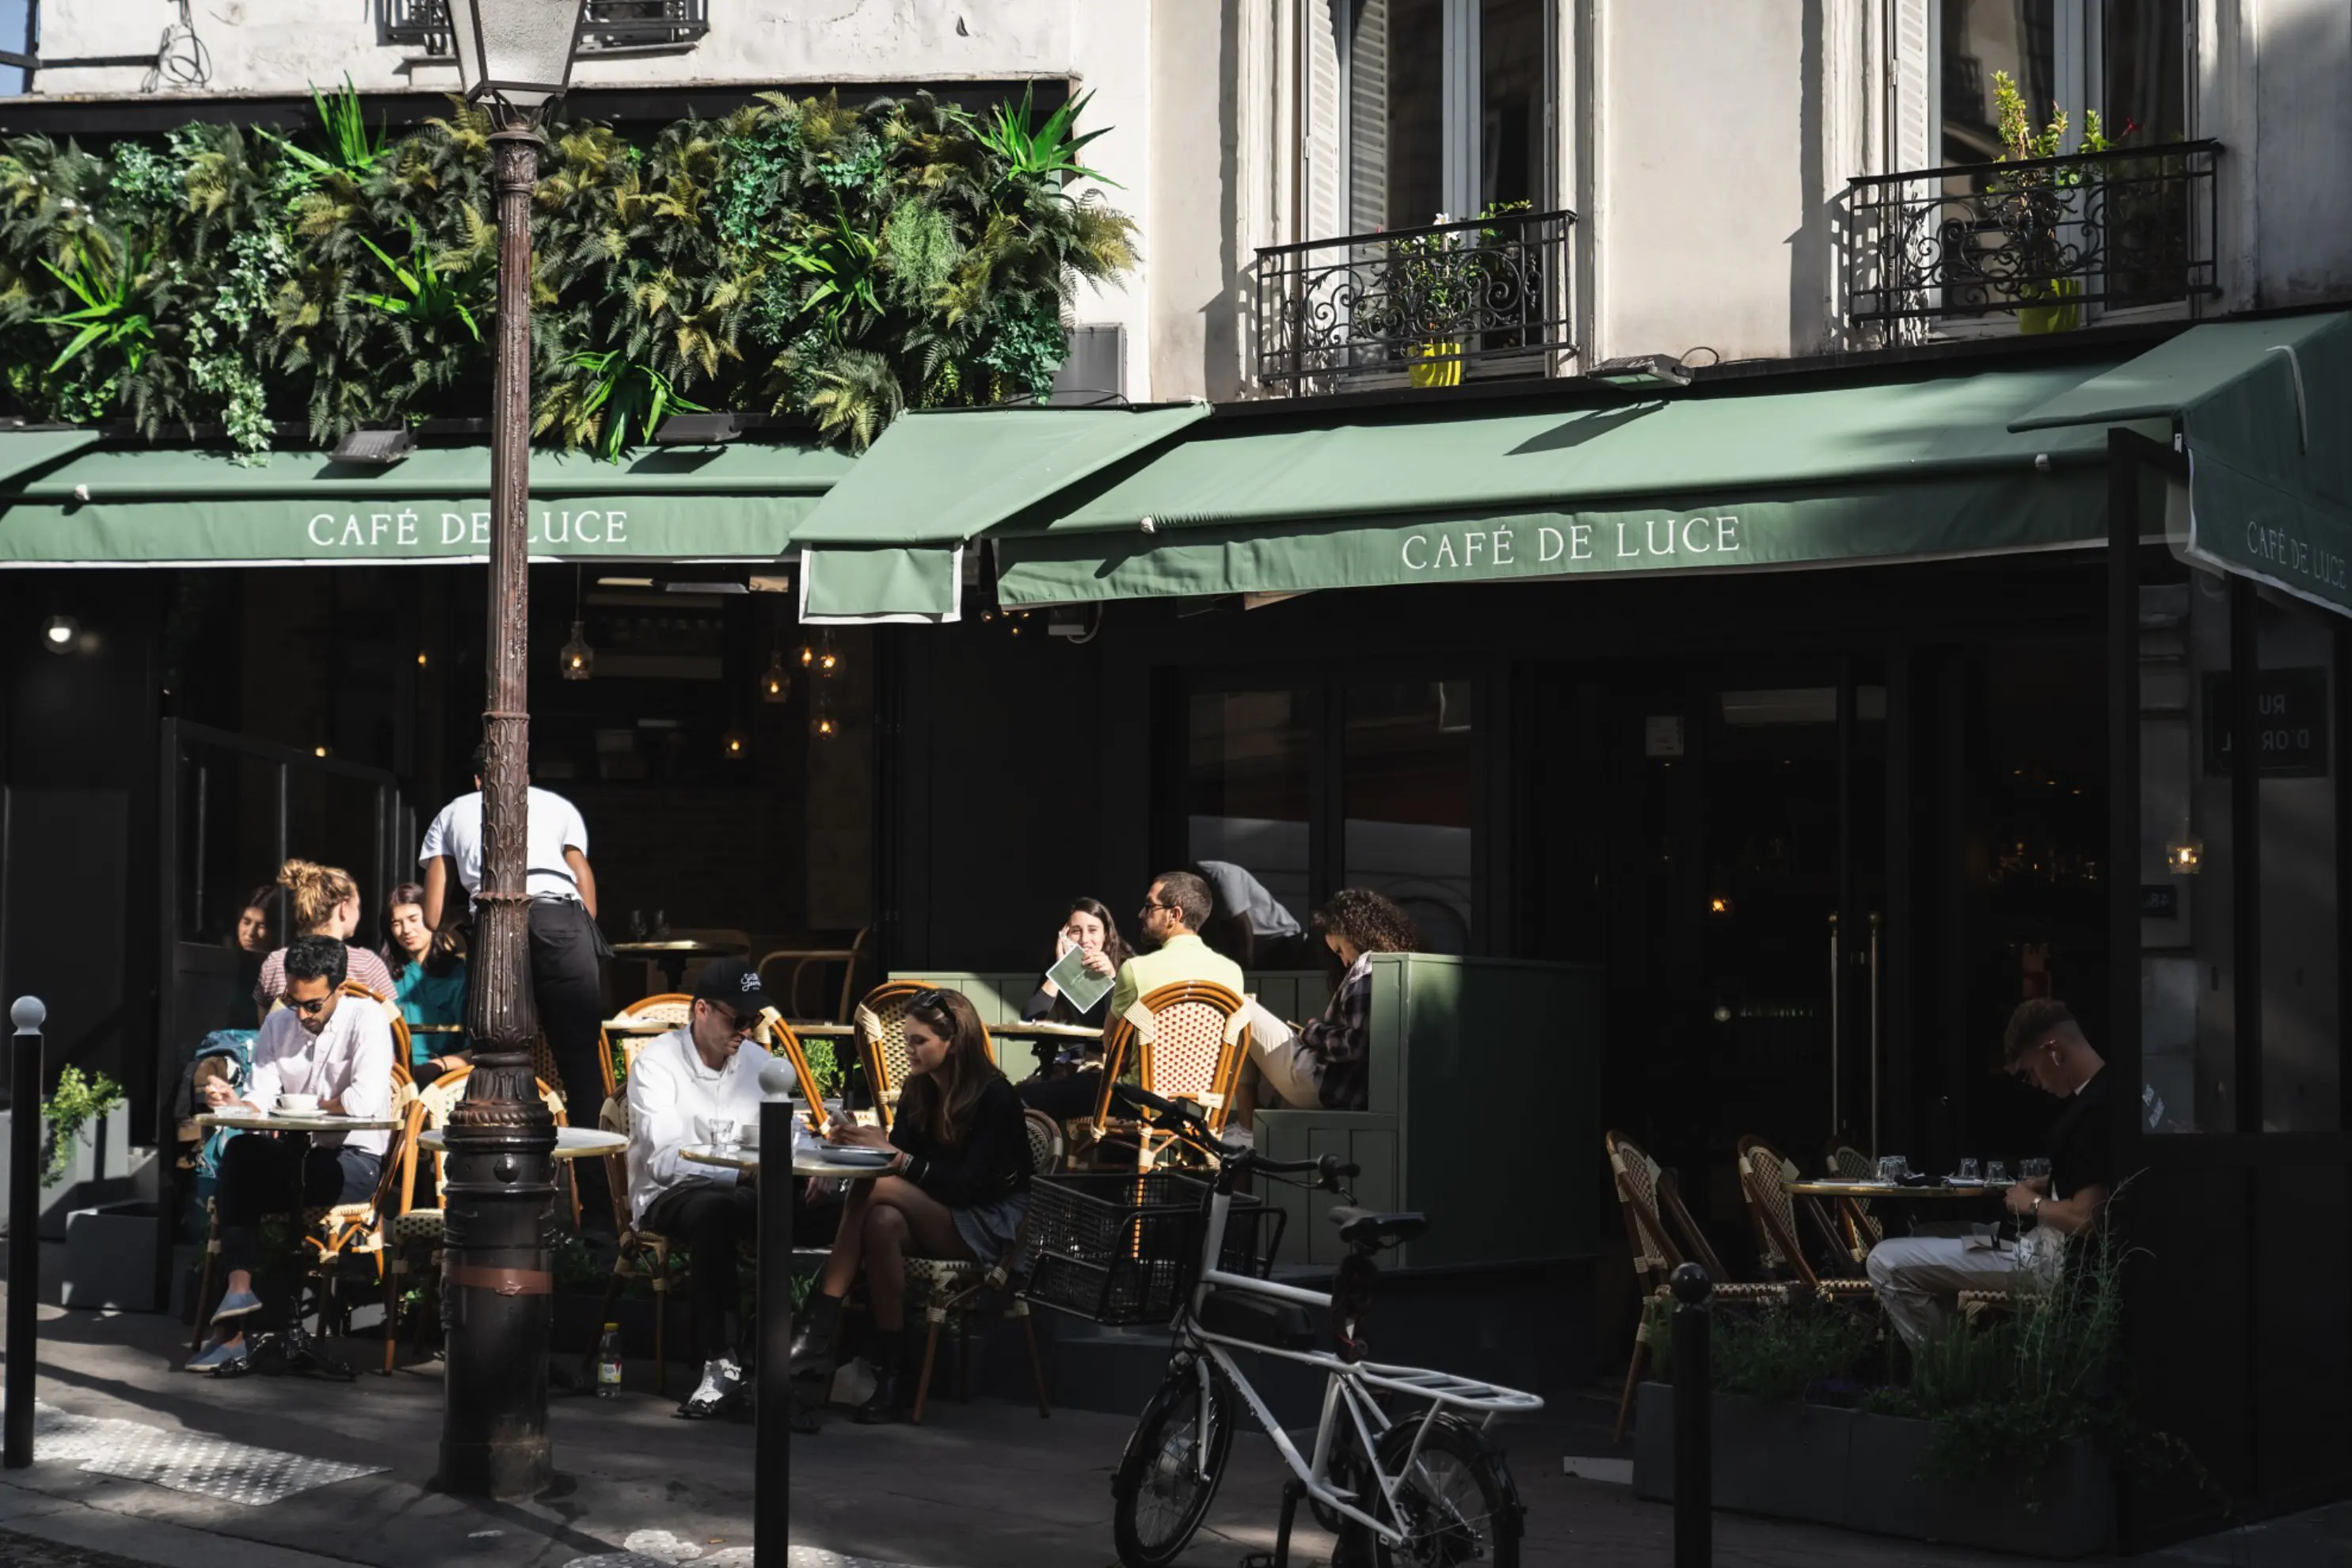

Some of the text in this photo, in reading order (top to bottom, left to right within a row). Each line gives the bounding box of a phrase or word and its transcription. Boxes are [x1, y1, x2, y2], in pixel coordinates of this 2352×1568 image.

[307, 508, 419, 546] CAFÉ
[440, 512, 491, 545] DE
[1402, 516, 1740, 570] CAFÉ DE LUCE
[2247, 520, 2346, 590] CAFÉ DE LUCE
